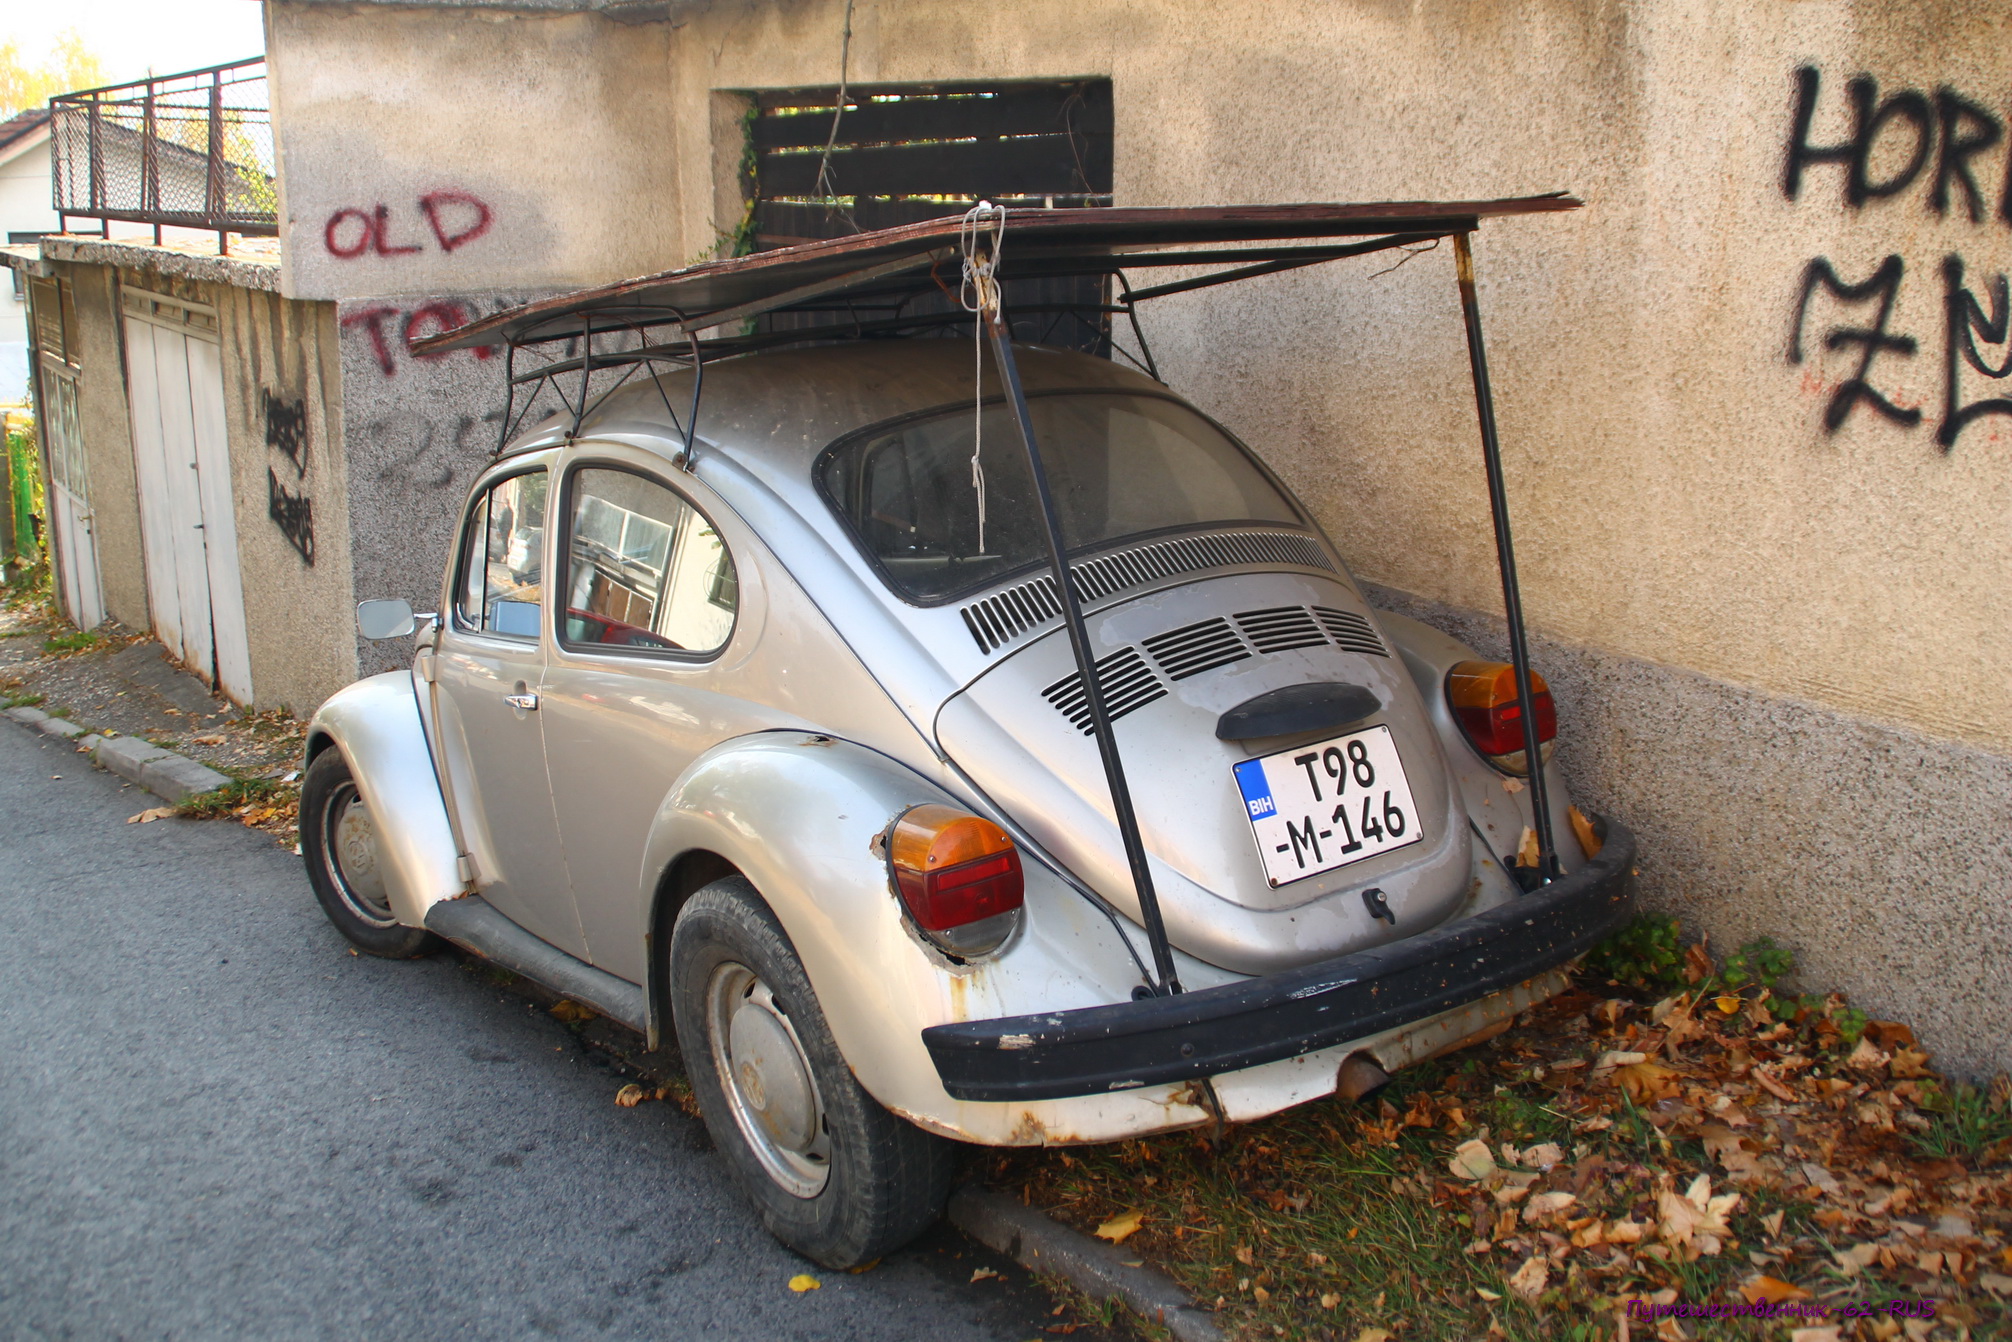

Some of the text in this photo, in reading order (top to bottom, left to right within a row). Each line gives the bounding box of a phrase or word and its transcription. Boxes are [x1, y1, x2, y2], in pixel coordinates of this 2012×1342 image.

[324, 189, 494, 260] OLD
[1294, 739, 1376, 802] T98
[1249, 796, 1274, 816] BIH
